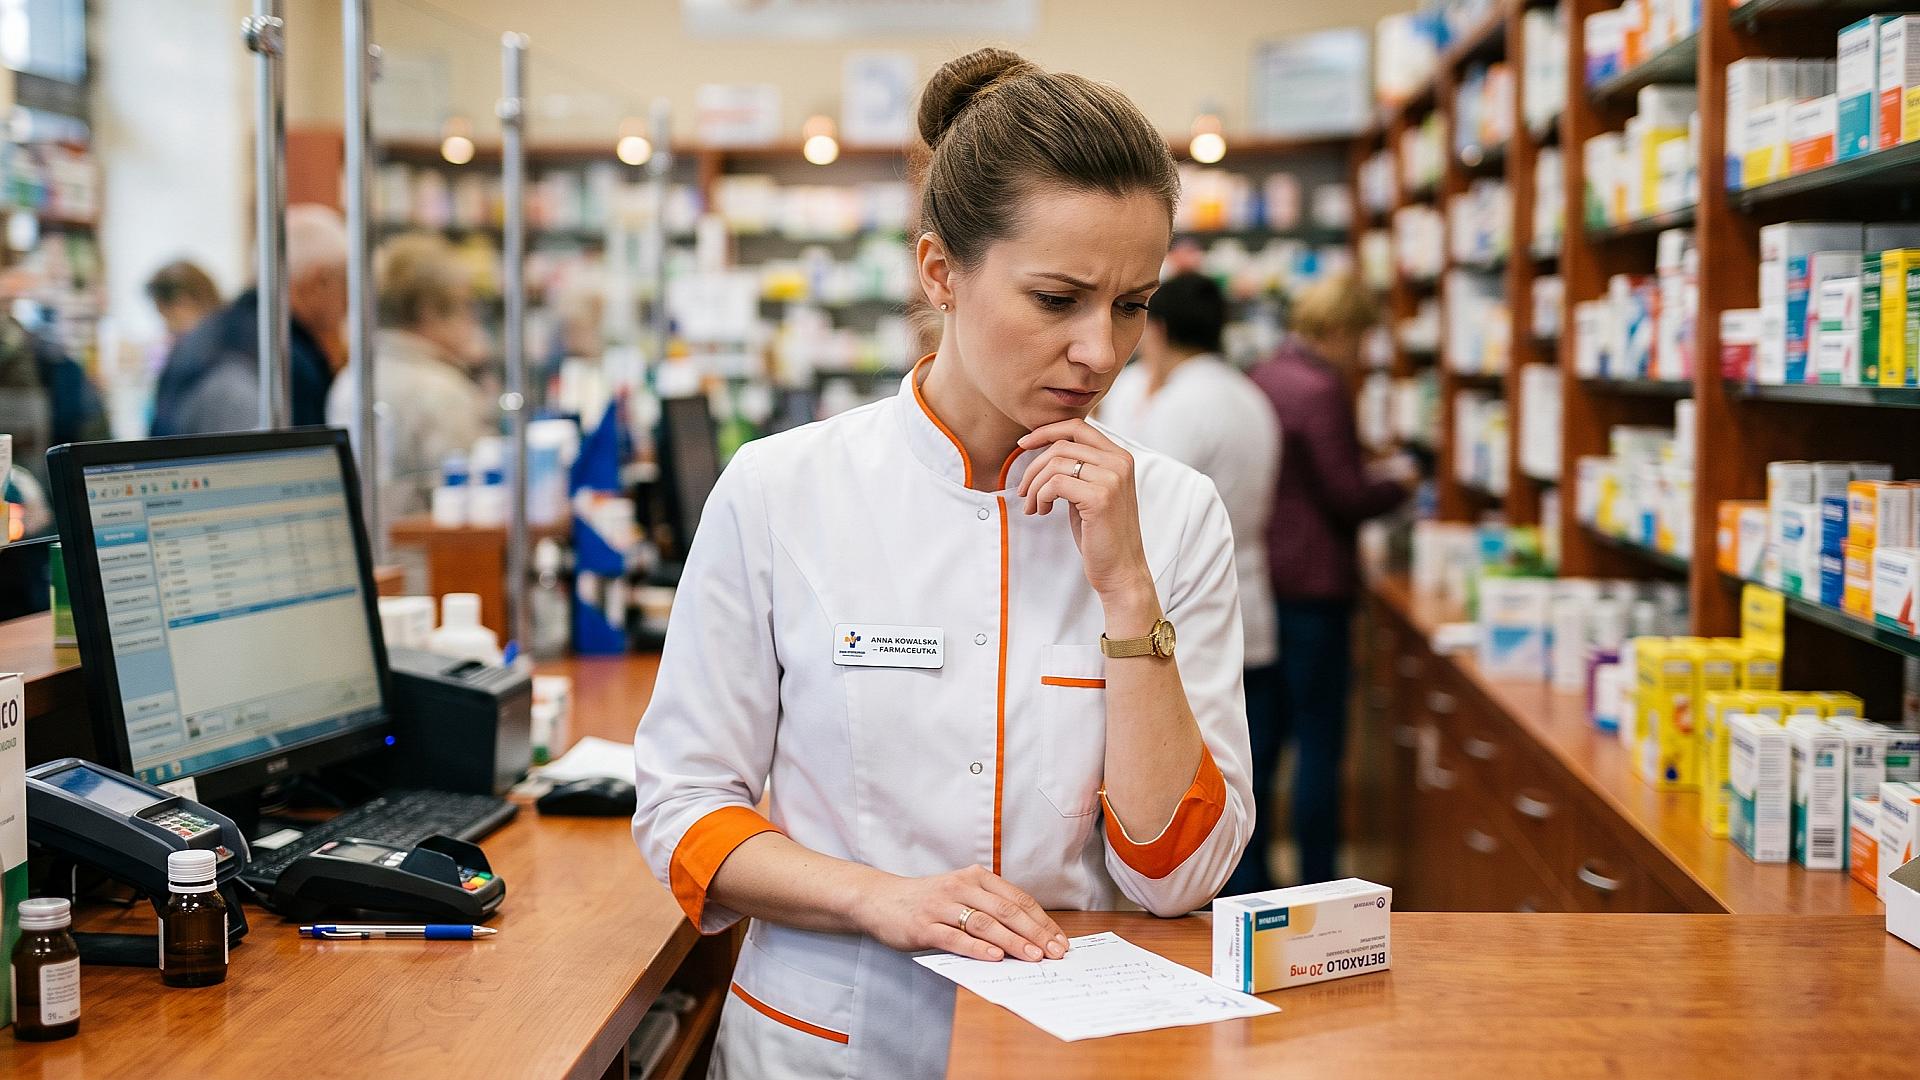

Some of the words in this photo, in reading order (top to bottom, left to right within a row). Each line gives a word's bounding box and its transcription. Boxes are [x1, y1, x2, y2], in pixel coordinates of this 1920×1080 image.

[895, 637, 938, 645] KOWALSKA
[879, 646, 937, 654] FARMACEUTKA
[0, 699, 17, 730] CO
[1326, 951, 1386, 973] BETAXOLO
[1290, 964, 1308, 977] mg
[1309, 963, 1324, 977] 20
